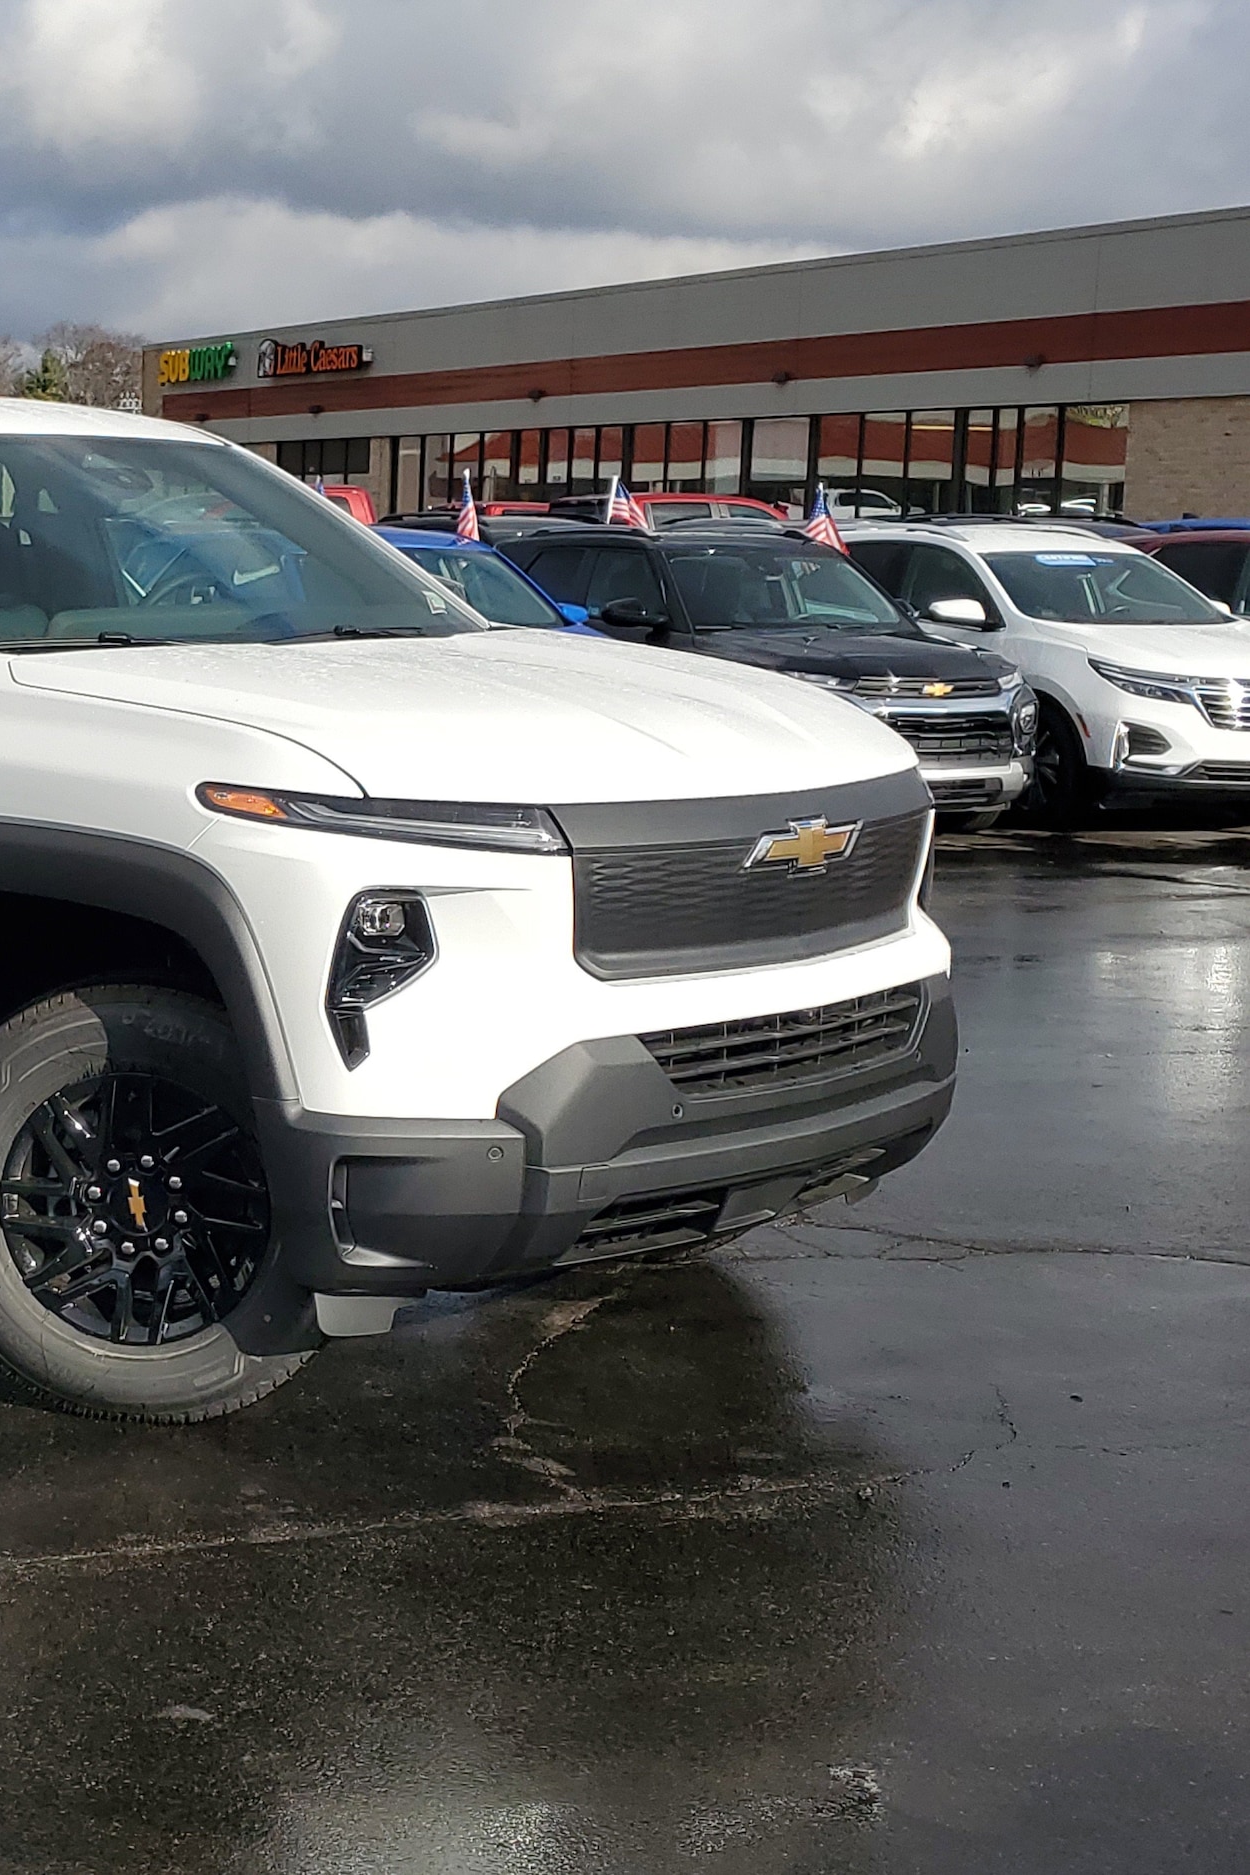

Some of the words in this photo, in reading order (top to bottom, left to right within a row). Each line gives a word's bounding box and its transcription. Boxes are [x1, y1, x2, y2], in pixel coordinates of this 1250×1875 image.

[158, 342, 233, 385] SUBWAY
[276, 345, 307, 375] Little
[311, 341, 359, 371] Caesars
